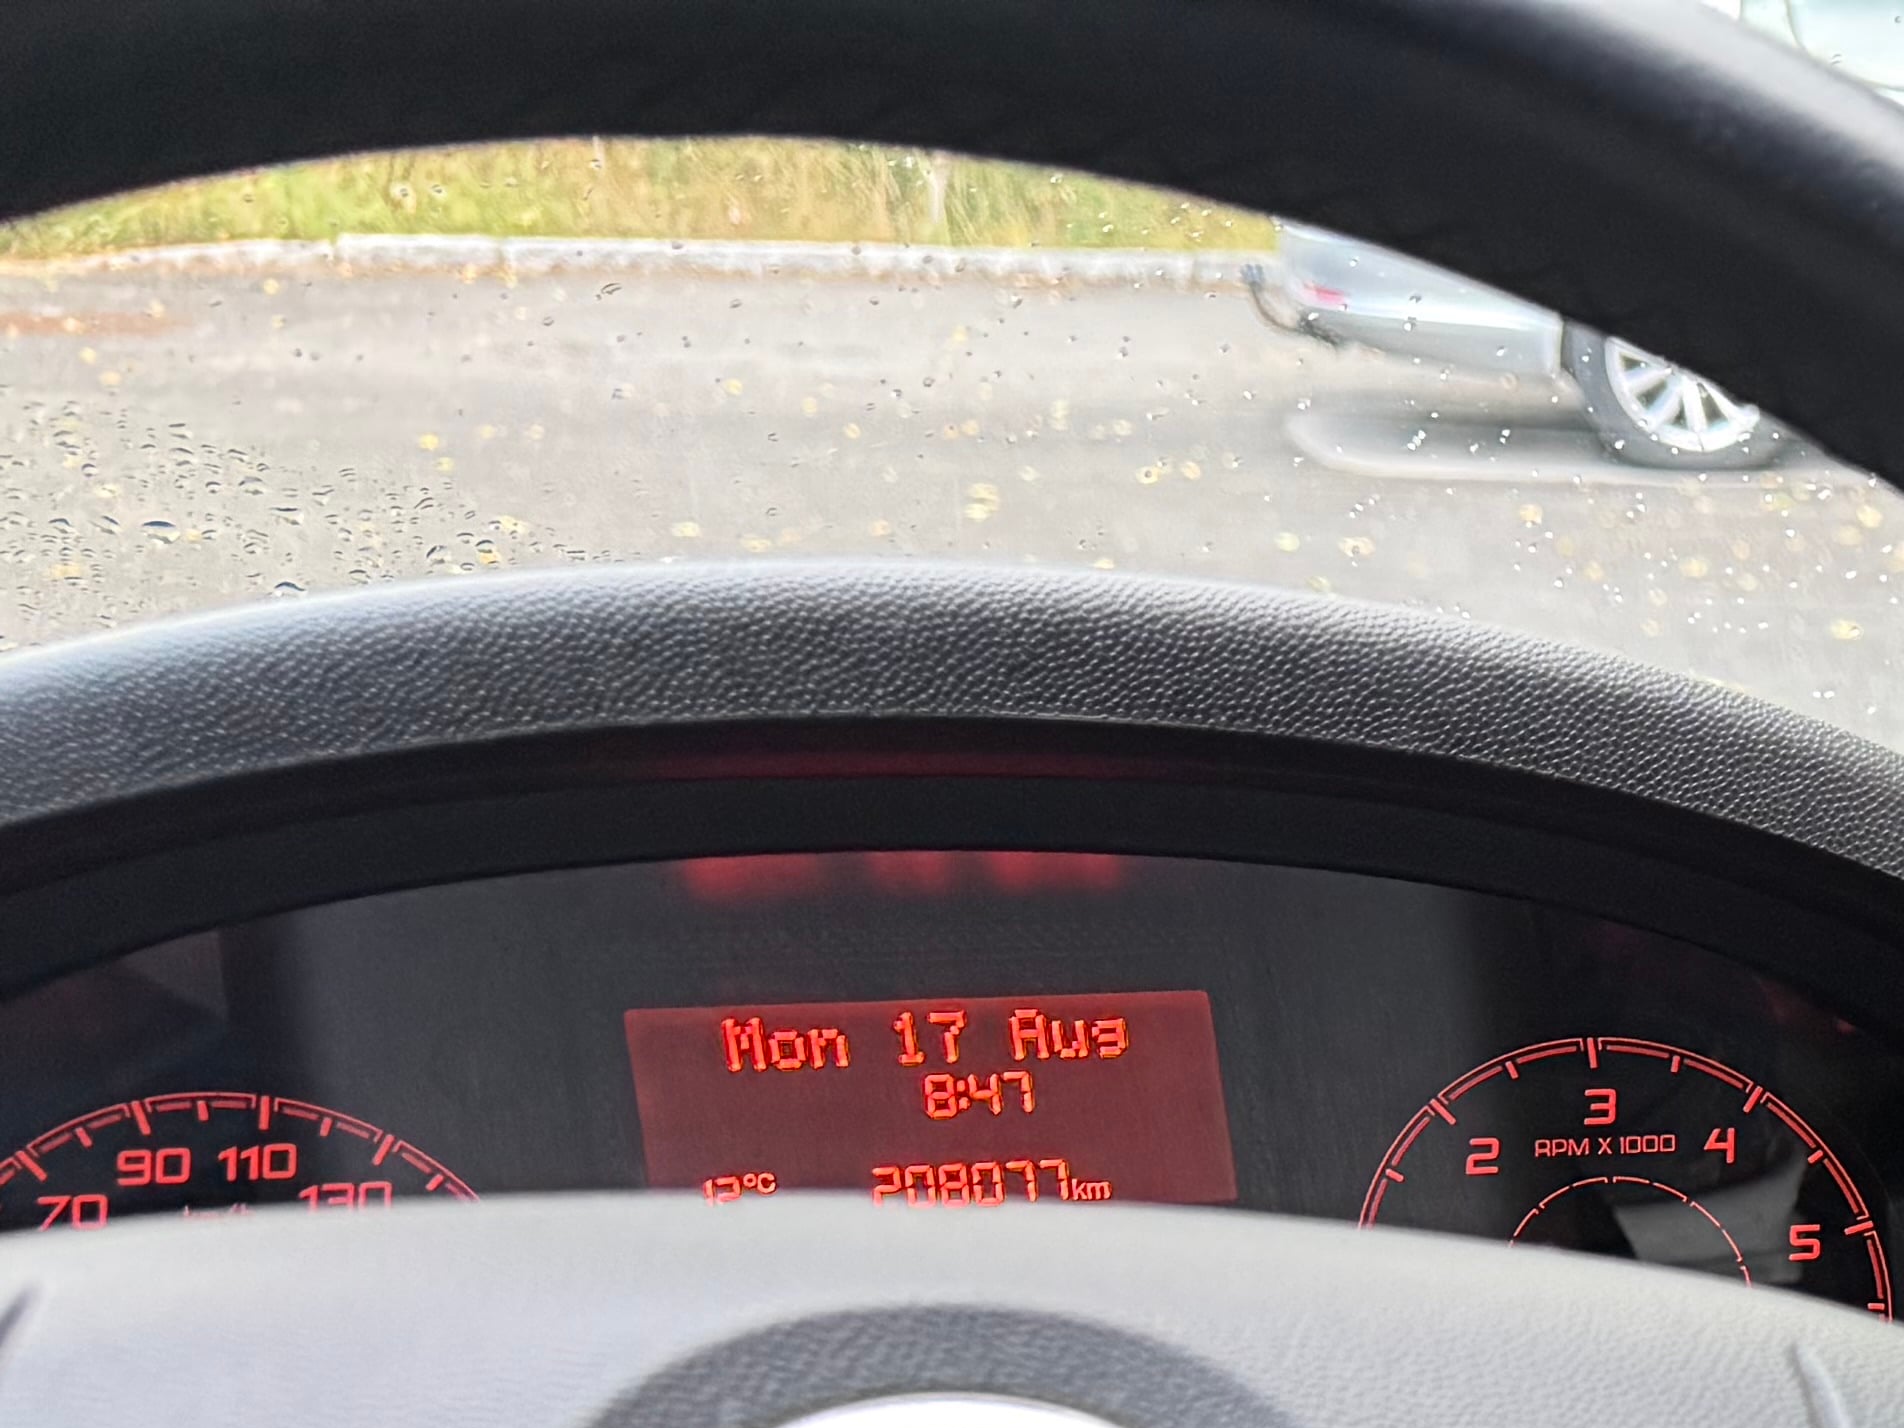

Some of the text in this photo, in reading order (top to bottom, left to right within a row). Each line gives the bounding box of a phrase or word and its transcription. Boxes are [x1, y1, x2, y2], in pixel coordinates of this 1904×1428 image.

[721, 1007, 1130, 1072] Mon 17 Aug
[923, 1069, 1035, 1120] 8:47
[1584, 1088, 1617, 1125] 3
[217, 1142, 297, 1182] 110
[1465, 1137, 1501, 1176] 2
[1534, 1133, 1677, 1158] RPM X 1000
[1703, 1127, 1736, 1164] 4
[116, 1147, 192, 1186] 90
[872, 1157, 1070, 1208] 208077
[36, 1194, 109, 1232] 70
[1788, 1223, 1821, 1262] 5
